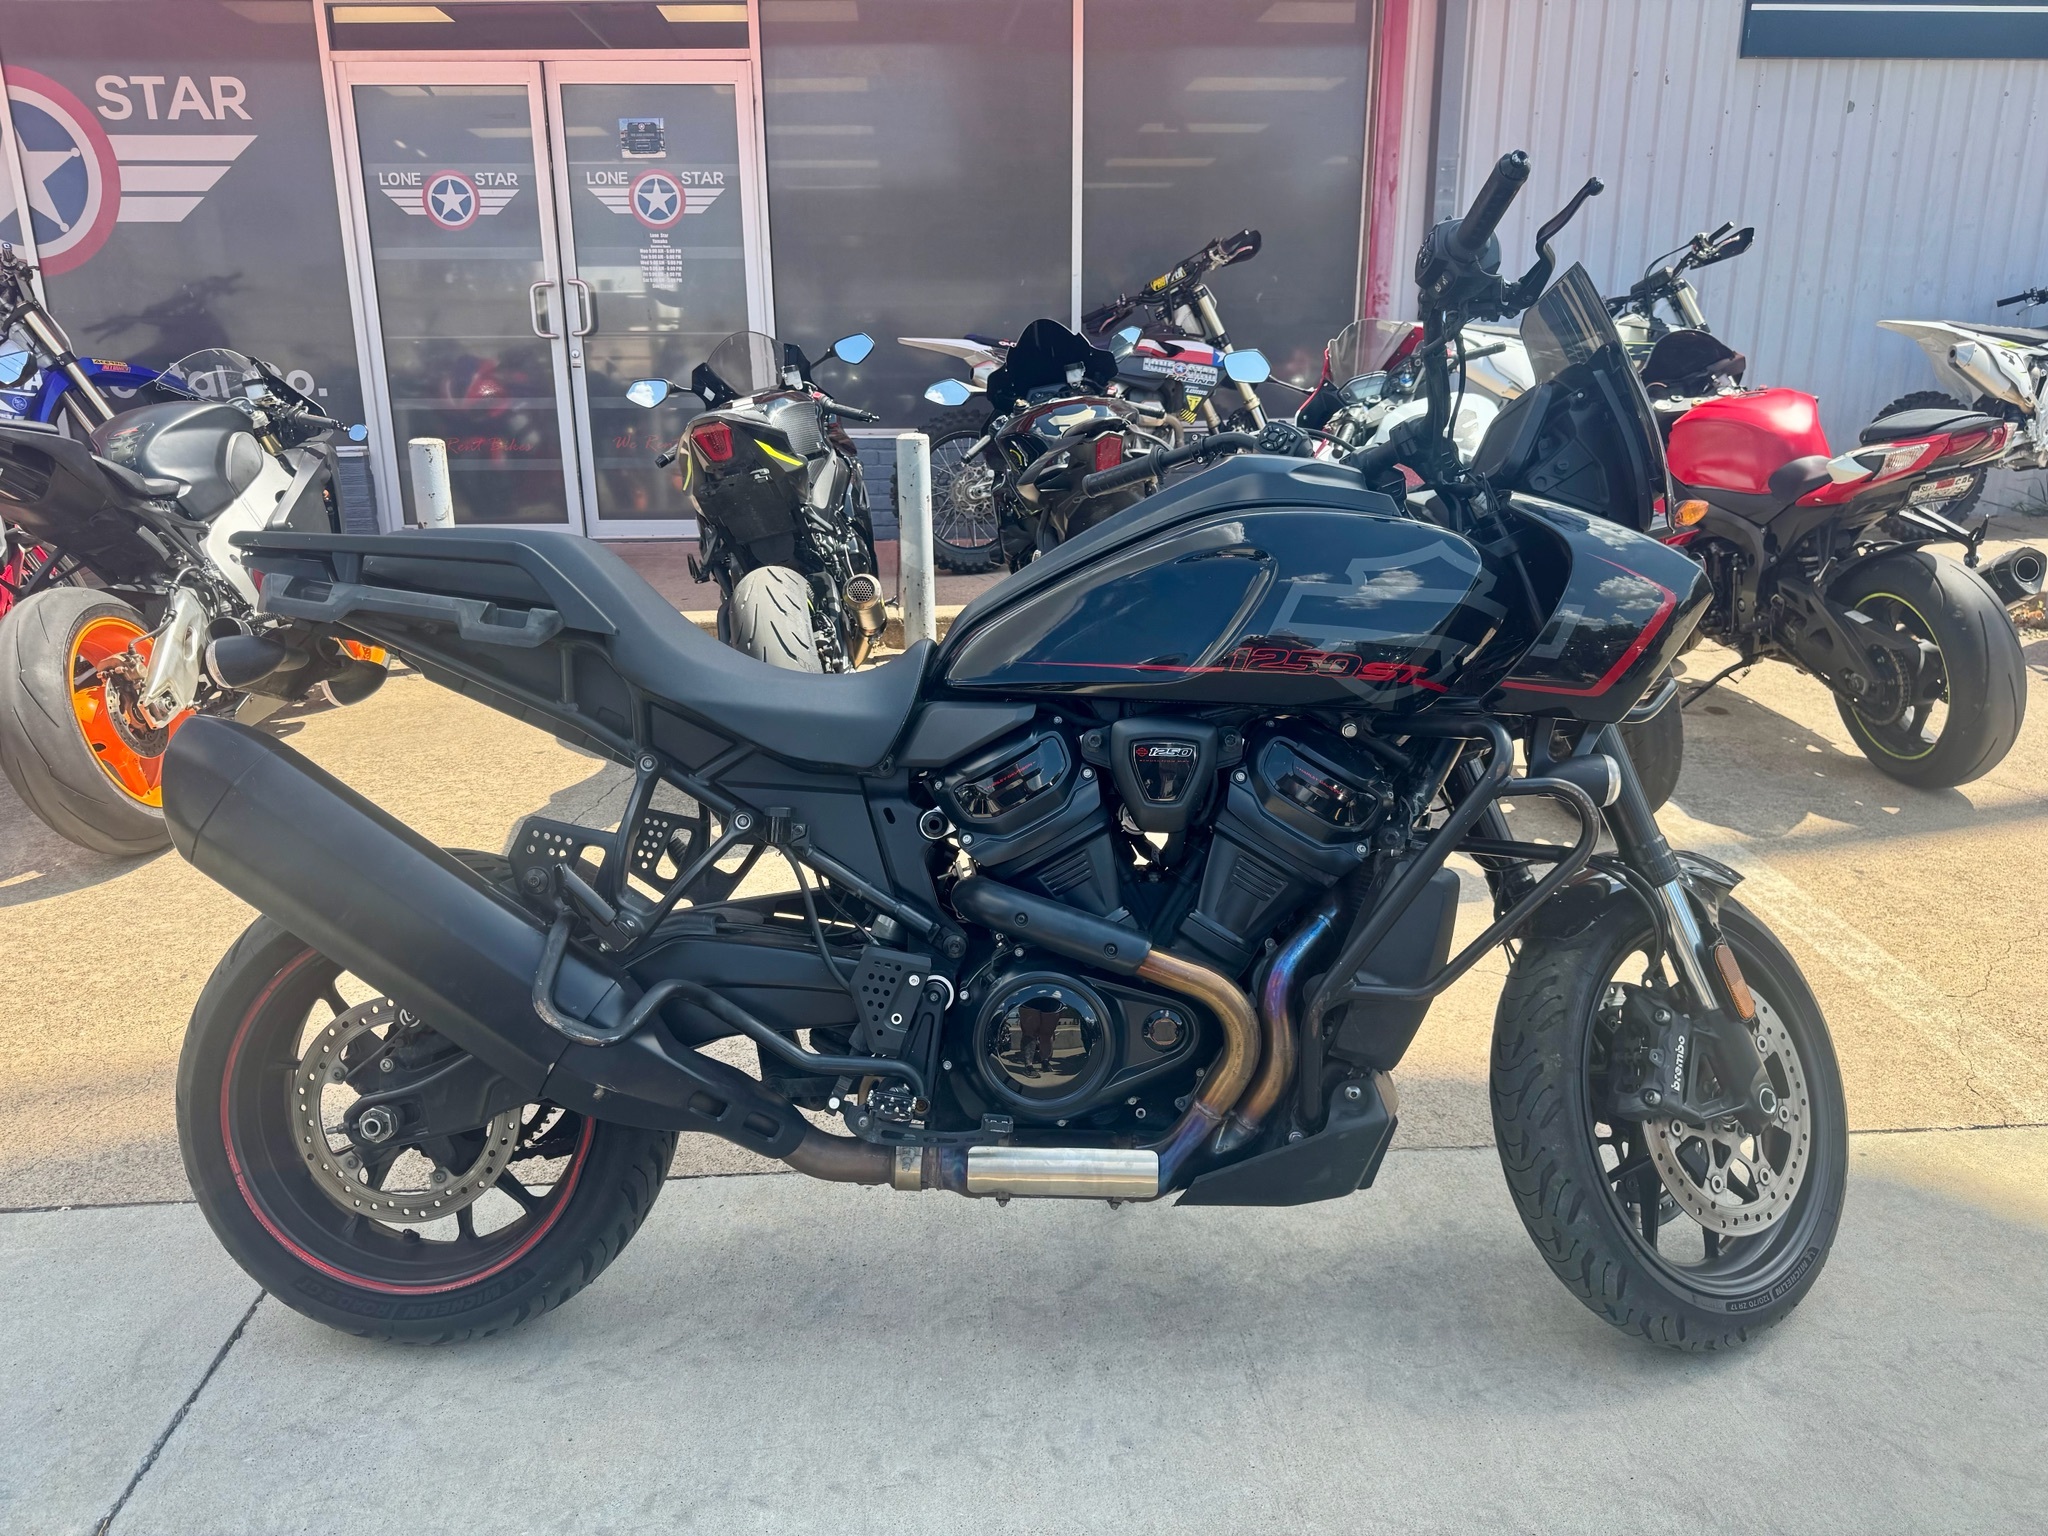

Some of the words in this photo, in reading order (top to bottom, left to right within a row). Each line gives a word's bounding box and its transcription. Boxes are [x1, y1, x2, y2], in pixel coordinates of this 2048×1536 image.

[95, 74, 253, 121] STAR
[378, 172, 422, 186] LONE
[474, 172, 519, 186] STAR
[586, 171, 629, 185] LONE
[681, 171, 725, 185] STAR
[1228, 646, 1363, 679] 1250
[1354, 661, 1429, 683] ST
[1149, 747, 1193, 758] 1250
[1670, 1035, 1686, 1092] brembo
[1774, 1262, 1809, 1297] MICHELIN
[1749, 1294, 1770, 1308] 120/70
